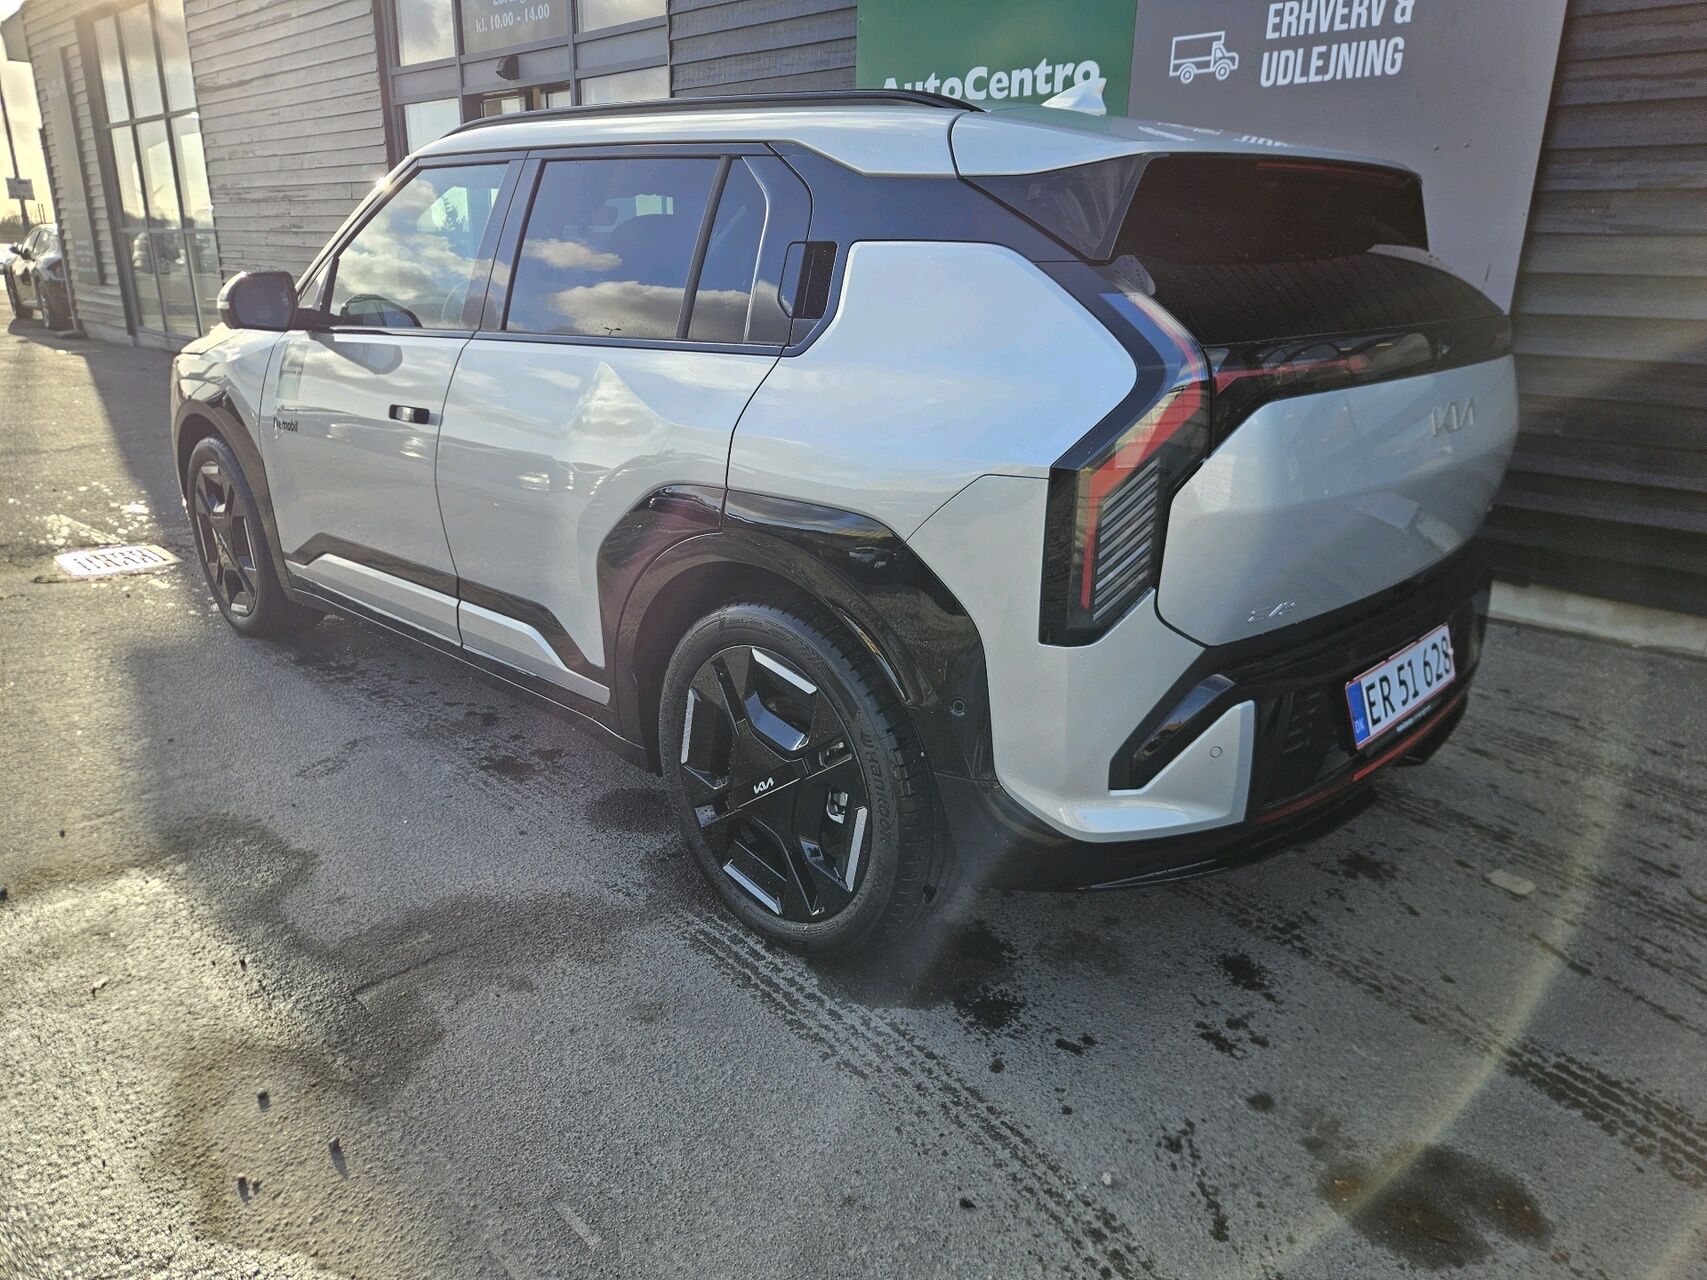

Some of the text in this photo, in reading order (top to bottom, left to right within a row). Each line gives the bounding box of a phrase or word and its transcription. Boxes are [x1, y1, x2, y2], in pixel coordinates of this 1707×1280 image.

[475, 18, 488, 33] kl.
[490, 12, 514, 30] 10.00
[524, 3, 550, 22] 14.00
[1265, 0, 1386, 40] ERHVERV
[1260, 36, 1405, 88] UDLEJNING
[1365, 675, 1396, 727] ER
[1397, 659, 1420, 706] 51
[1423, 636, 1452, 688] 628
[1354, 717, 1366, 734] DK
[753, 777, 774, 794] KIA
